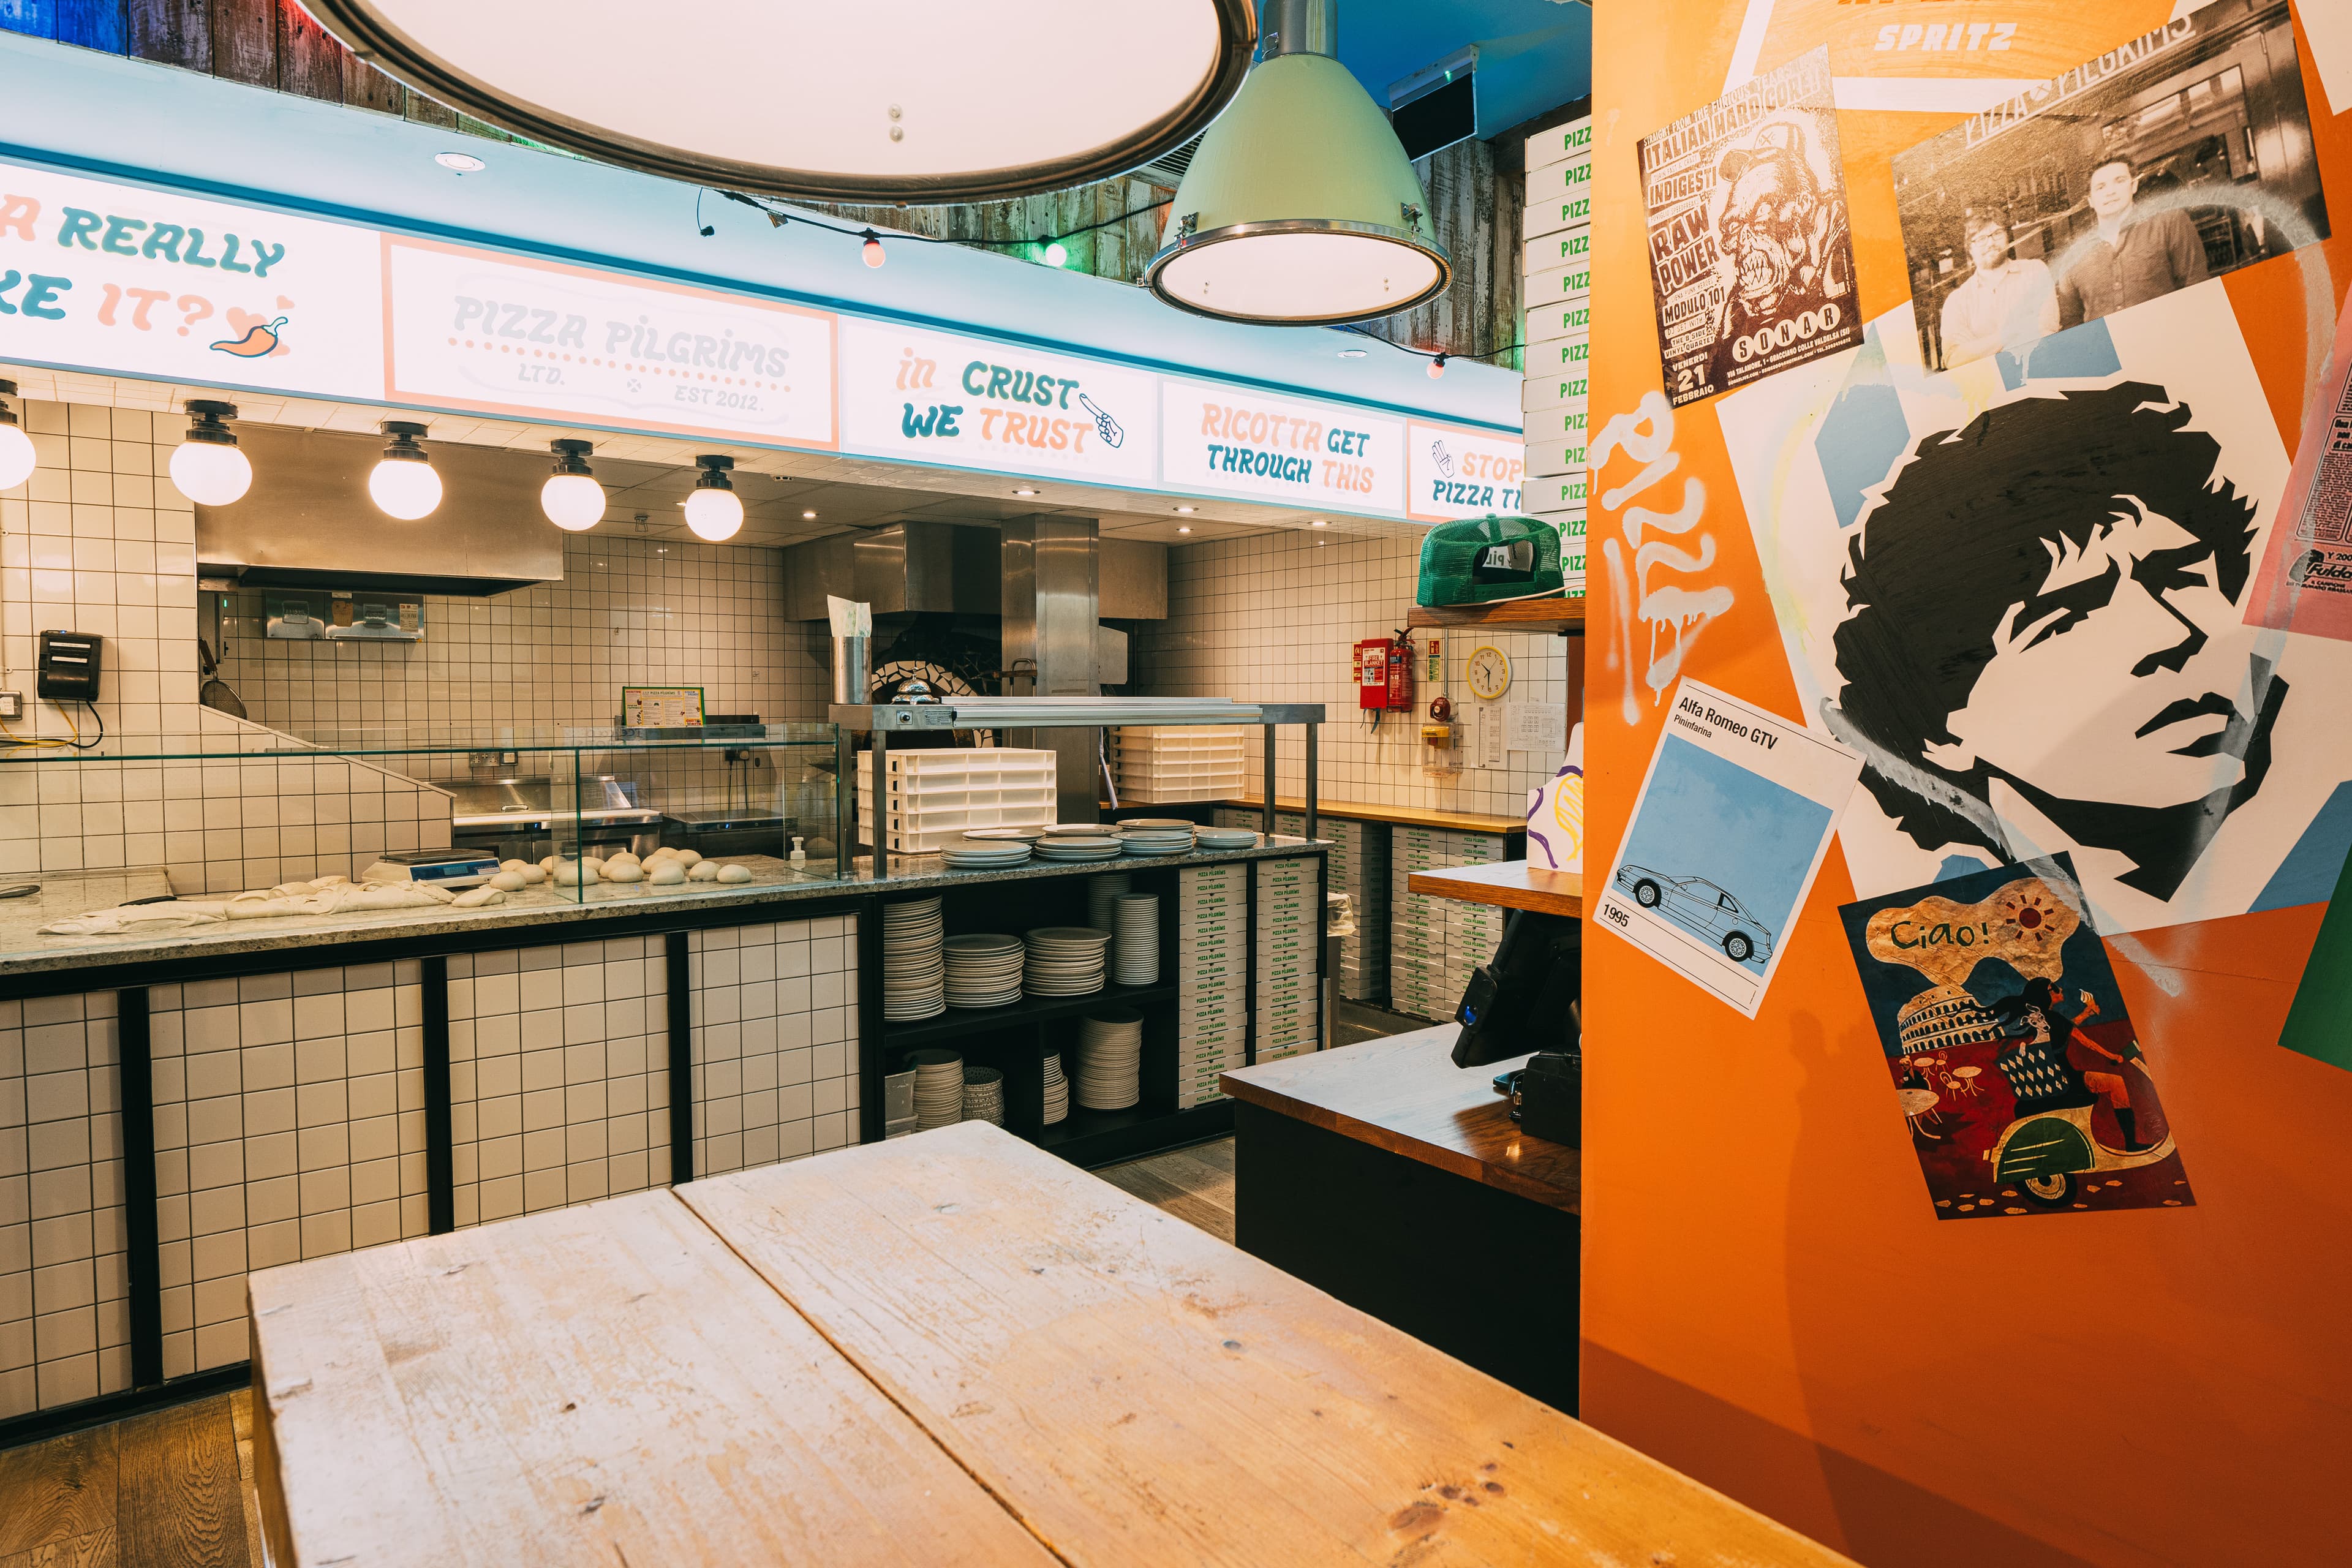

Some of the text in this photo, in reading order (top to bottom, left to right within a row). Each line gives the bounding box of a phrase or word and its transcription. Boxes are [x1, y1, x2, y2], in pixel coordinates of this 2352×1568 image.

[1874, 23, 2017, 51] SPRITZ
[1564, 126, 1591, 150] PIZZ
[1643, 127, 1670, 146] STRAIGHT
[1672, 115, 1692, 133] FROM
[1693, 105, 1709, 121] THE
[1645, 119, 1711, 170] ITALIAN
[1714, 96, 1762, 138] HARD
[1649, 166, 1717, 206] INDIGESTI
[1562, 198, 1589, 221] PIZZ
[57, 206, 285, 277] REALLY
[1561, 235, 1589, 257] PIZZ
[1651, 203, 1710, 262] RAW
[1659, 236, 1720, 293] POWER
[97, 283, 214, 336] IT?
[1664, 287, 1725, 324] MODULO 101
[453, 295, 790, 378] PIZZA PiLGRiMS
[1672, 337, 1684, 345] THE
[1691, 329, 1706, 339] SIDE
[1678, 322, 1686, 331] SET
[1738, 307, 1834, 359] SONAR
[1561, 343, 1589, 363] PIZZ
[1665, 336, 1714, 357] VINYL QUARTET
[1727, 370, 1736, 379] VIA
[1797, 340, 1814, 353] COLLE
[1814, 331, 1840, 346] VALDELSA
[518, 363, 764, 412] LTD. EST 2012.
[895, 347, 1080, 410] in CRUST
[1560, 379, 1588, 399] PIZZ
[1672, 383, 1714, 406] FEBBRAIO
[1677, 364, 1706, 393] 21
[901, 402, 1094, 454] WE TRUST
[1201, 402, 1370, 458] RICOTTA GET
[1207, 444, 1374, 494] THROUGH THIS
[1462, 451, 1523, 483] STOP
[1565, 447, 1586, 464] PIZ
[1433, 479, 1494, 507] PIZZA
[1559, 519, 1586, 538] PIZZ
[1674, 714, 1713, 739] Pininfarina
[1678, 697, 1778, 750] Alfa Romeo GTV
[1603, 903, 1630, 927] 1995
[1890, 921, 1989, 950] Ciao!
